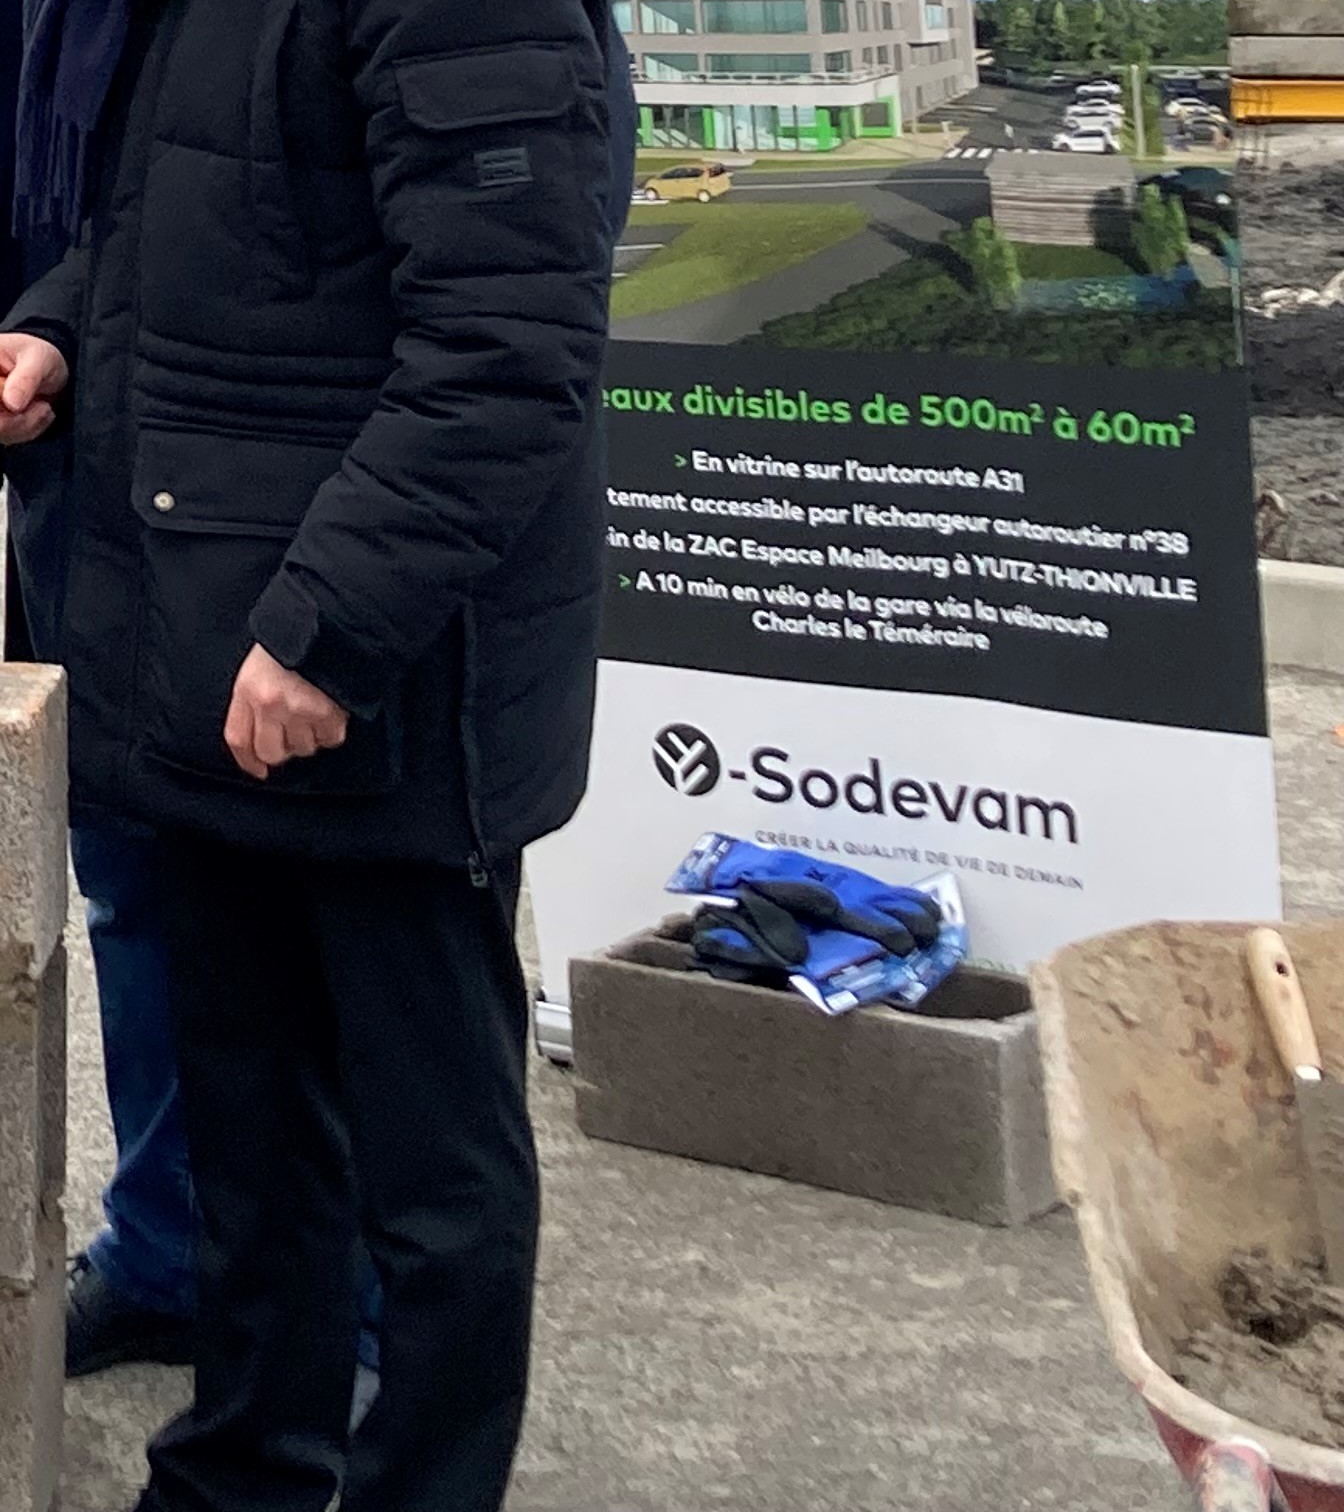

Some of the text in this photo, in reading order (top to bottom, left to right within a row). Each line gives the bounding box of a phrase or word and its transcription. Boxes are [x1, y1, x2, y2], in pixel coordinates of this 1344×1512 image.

[683, 385, 851, 424] divisibles
[862, 393, 910, 426] de
[920, 395, 1045, 436] 500m²
[1052, 406, 1079, 440] à
[1087, 410, 1196, 447] 60m²
[691, 450, 1024, 493] En vitrine sur l'autoroute A31
[691, 497, 805, 521] accessible
[808, 506, 850, 527] par
[853, 504, 990, 535] l'échangeur
[993, 518, 1123, 551] autoroutier
[605, 525, 1198, 602] in de la ZAC Espace Meilbourg à YUTZ-THIONVILLE
[635, 571, 1109, 638] A 10 min en vélo de la gare via la véloroute
[752, 609, 990, 650] Charles le Téméraire
[755, 829, 810, 850] CRÉER
[815, 838, 840, 853] LA
[843, 840, 920, 864] QUALITÉ
[925, 850, 951, 866] DE
[954, 854, 984, 872] VIE
[987, 859, 1009, 877] DE
